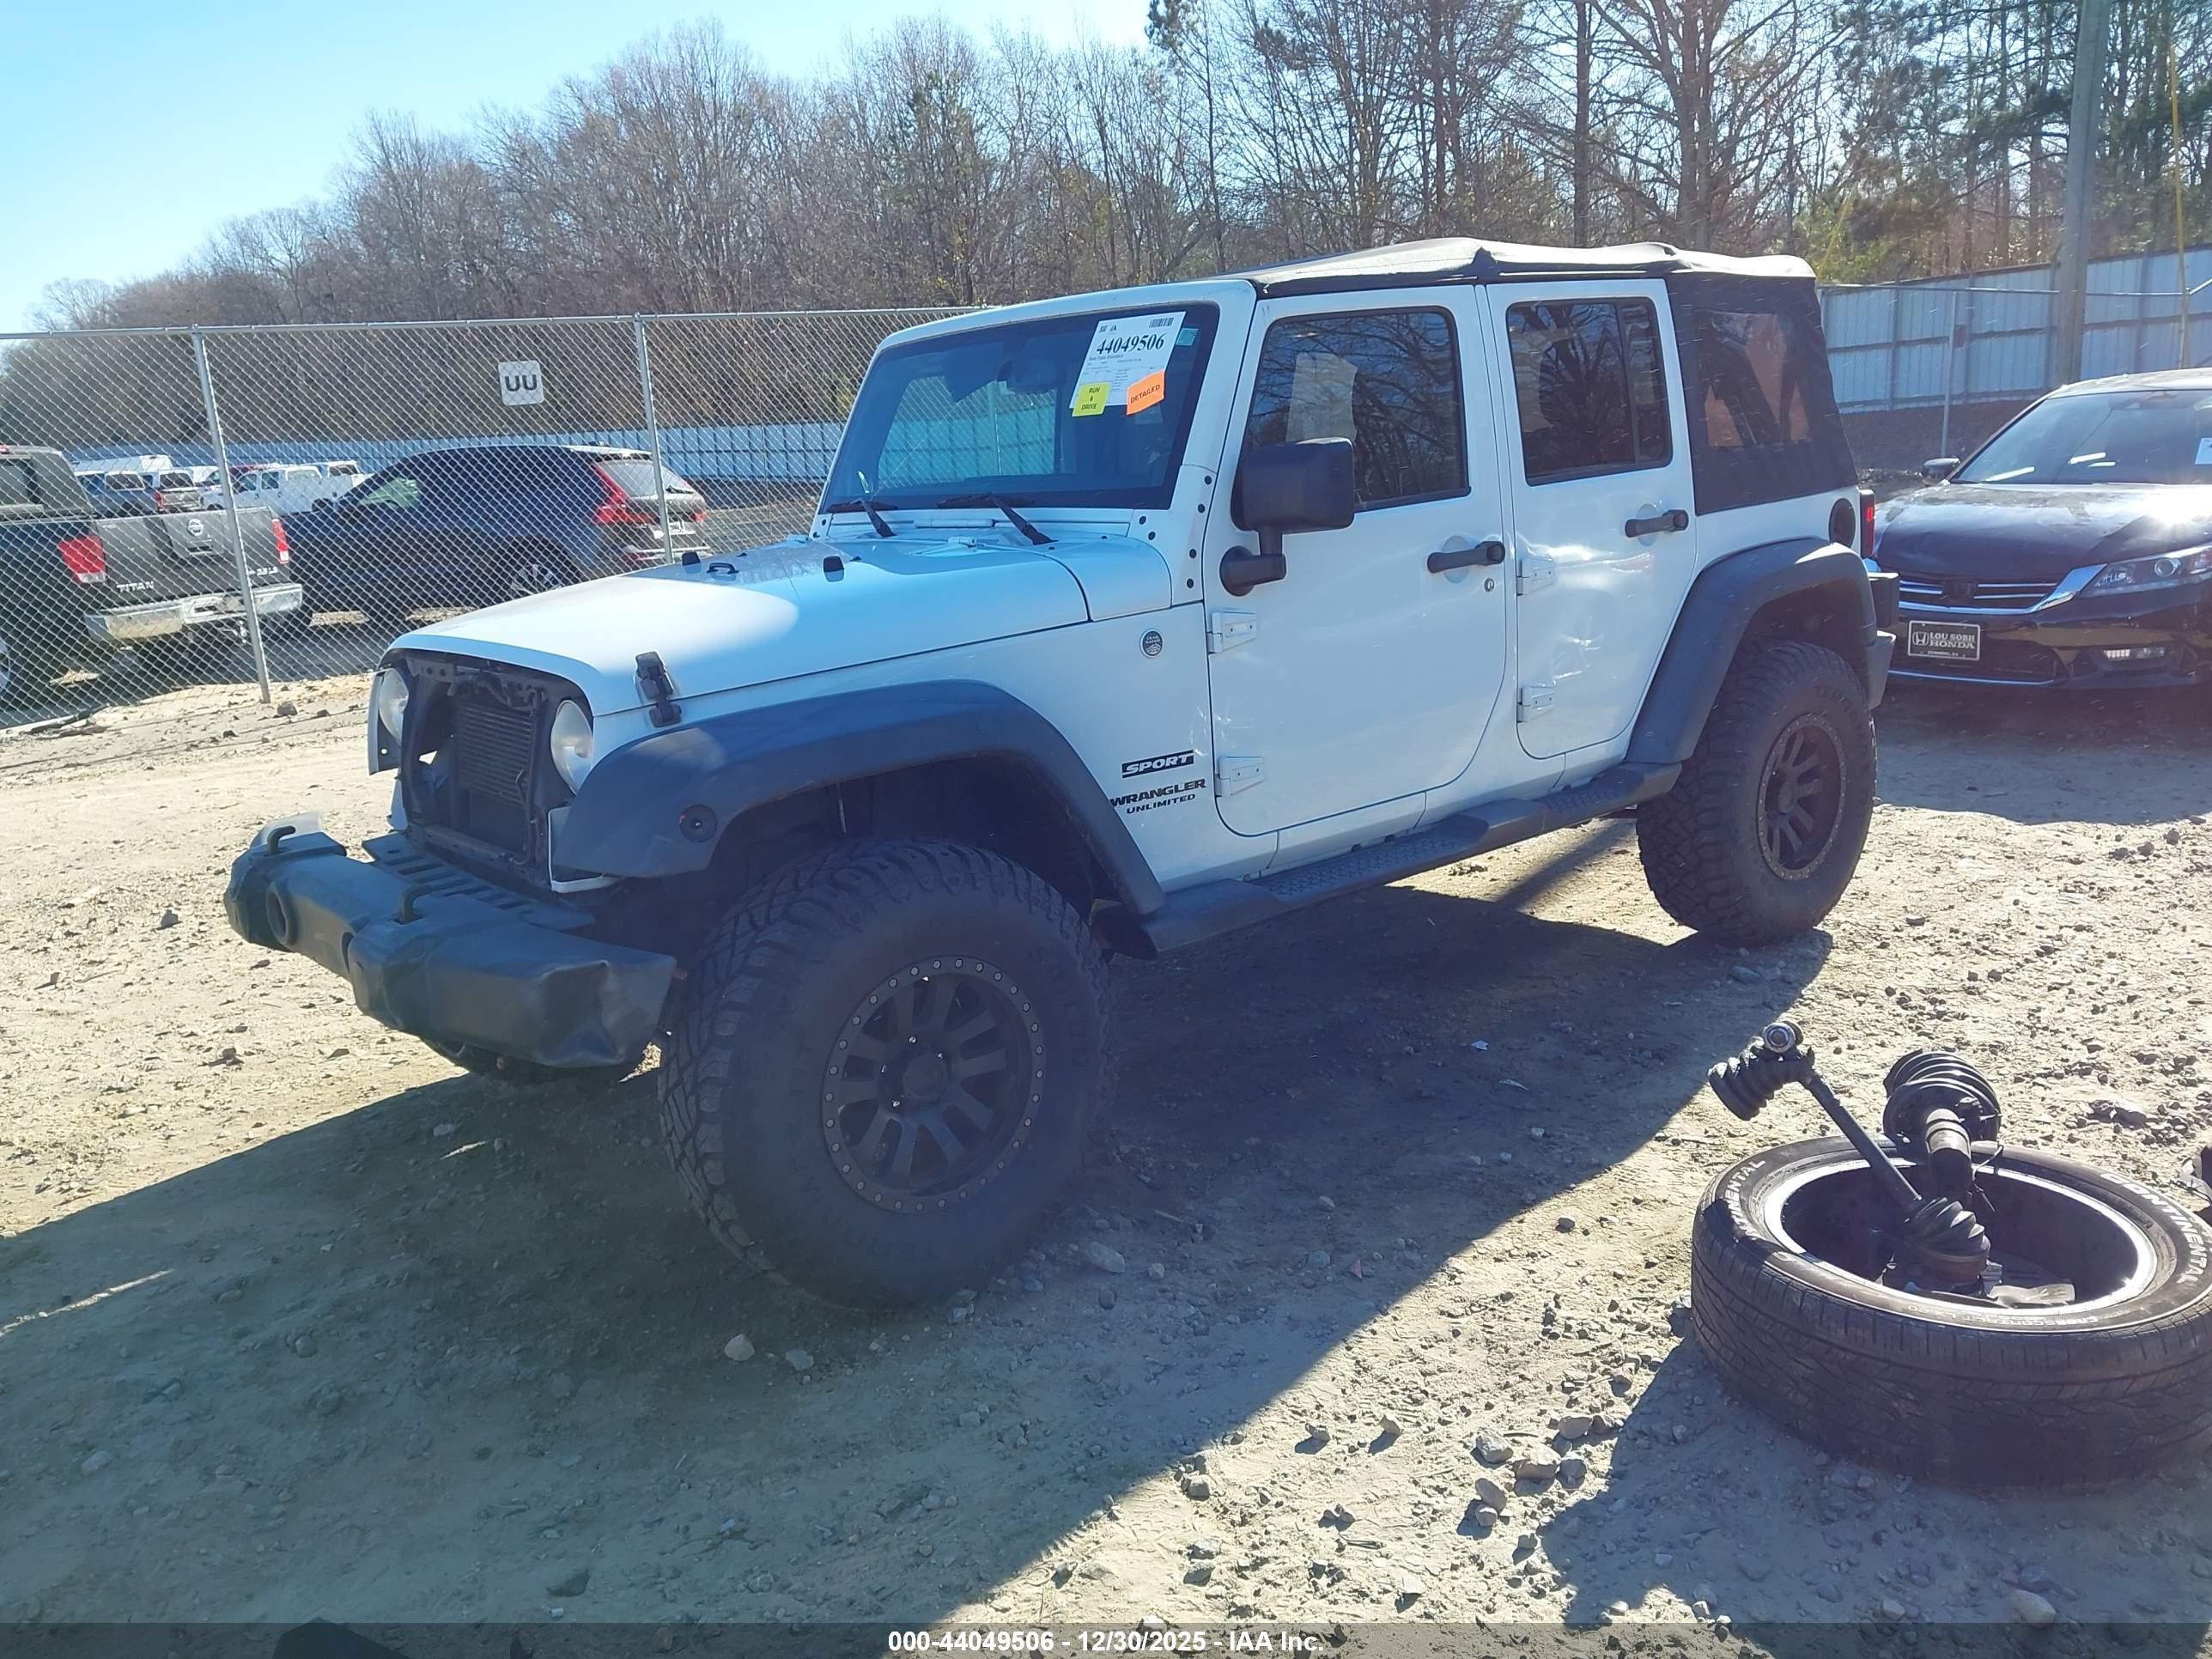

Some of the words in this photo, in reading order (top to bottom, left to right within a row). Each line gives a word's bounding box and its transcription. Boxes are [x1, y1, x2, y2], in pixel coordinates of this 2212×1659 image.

[1097, 333, 1166, 354] 44049506
[504, 374, 538, 392] UU
[116, 581, 155, 592] TITAN
[1929, 640, 1975, 649] HONDA
[1125, 754, 1189, 775] SPORT
[1109, 778, 1206, 807] WRANGLER
[1126, 793, 1196, 814] UNLIMITED
[2100, 1172, 2209, 1284] CONTINENTAL
